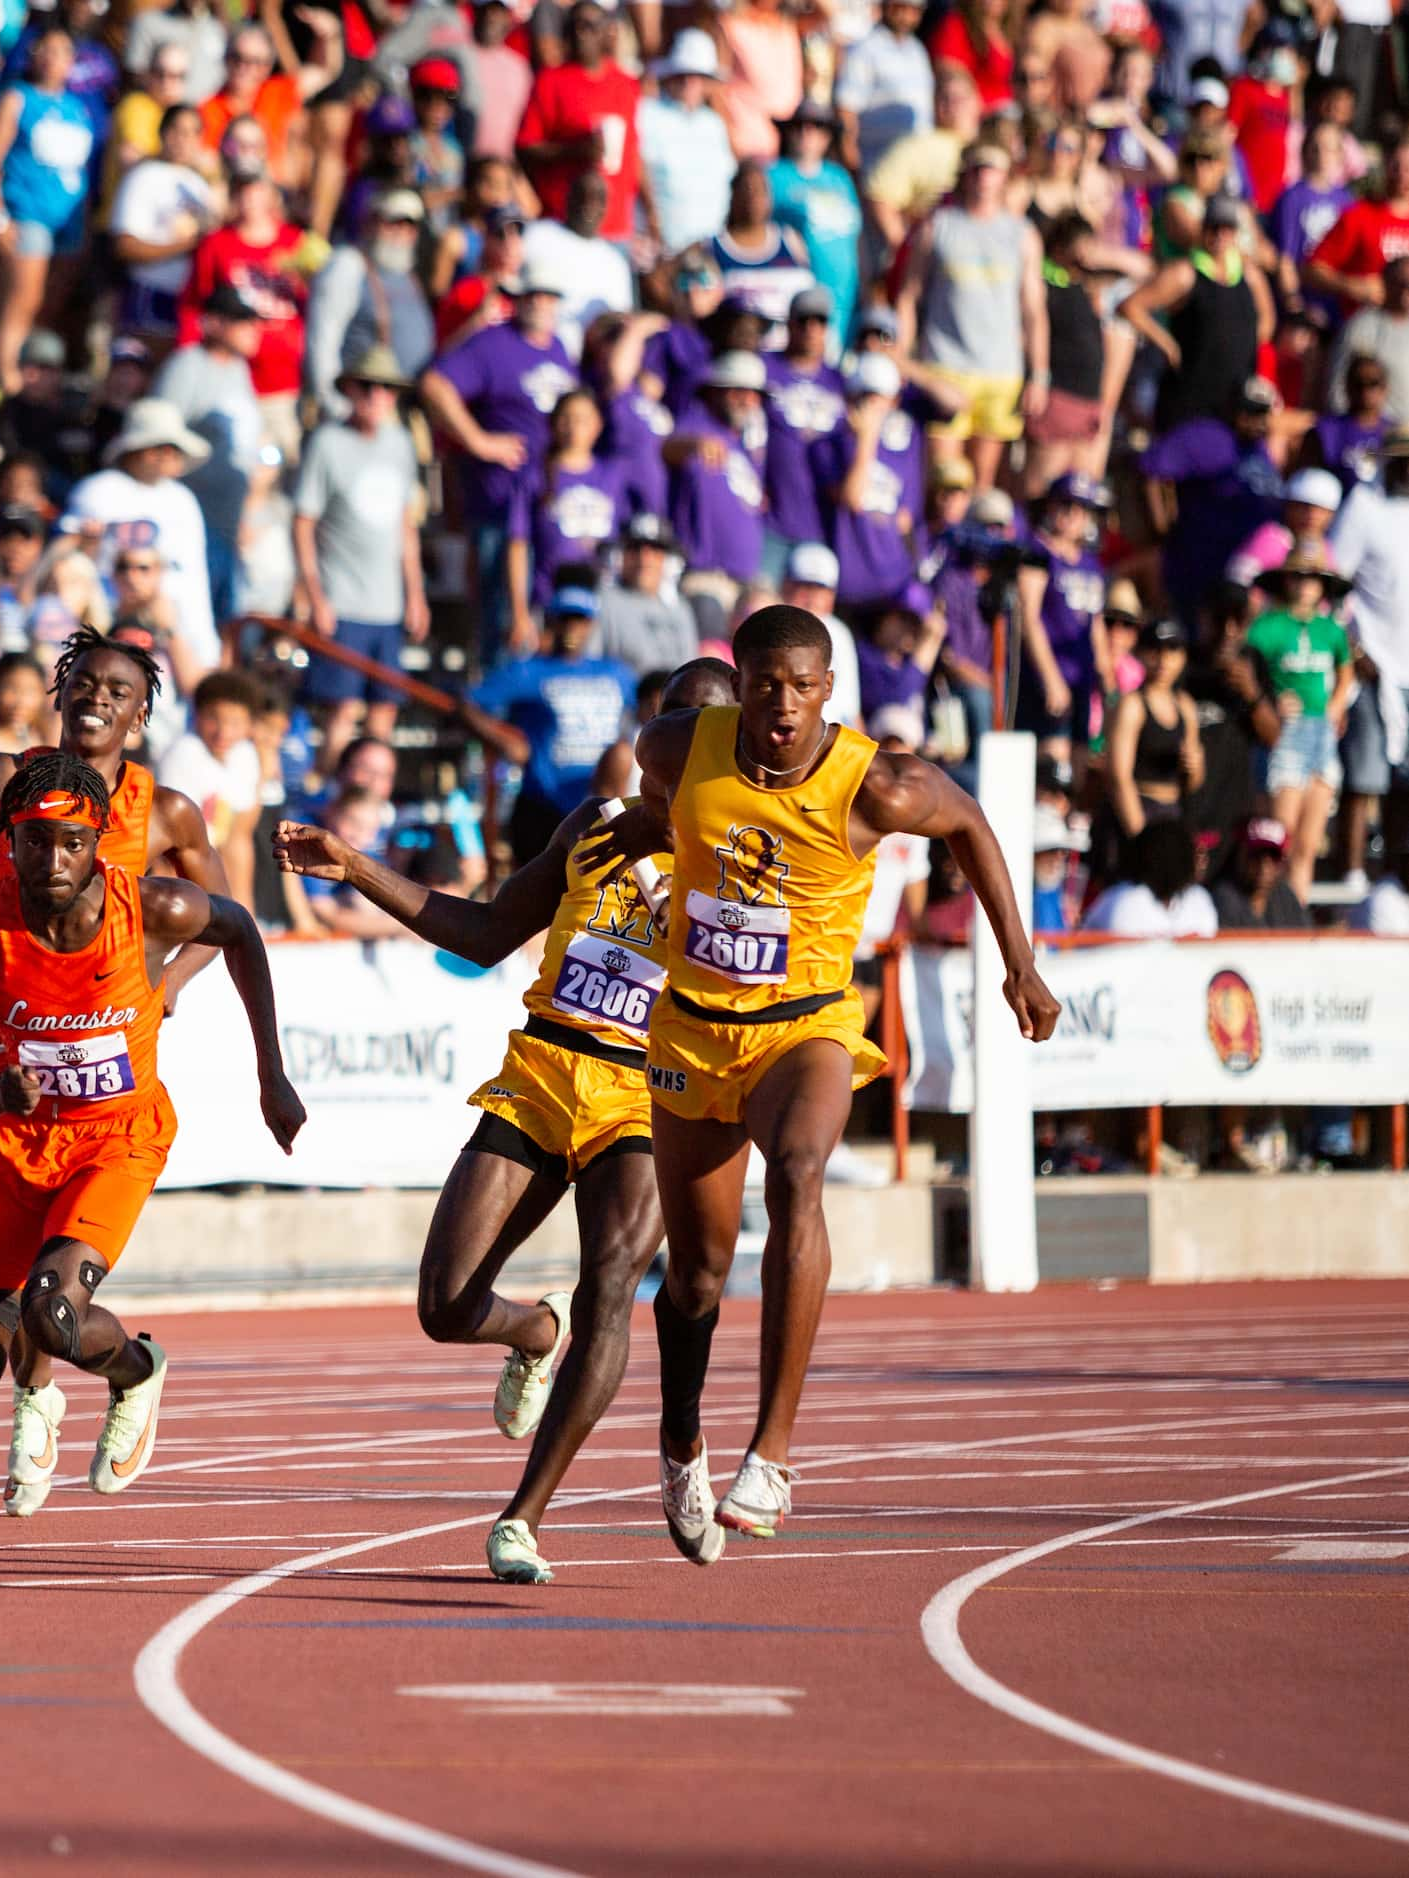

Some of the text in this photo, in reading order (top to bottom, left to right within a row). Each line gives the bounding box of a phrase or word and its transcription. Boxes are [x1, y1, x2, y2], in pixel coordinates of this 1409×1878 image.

[694, 927, 779, 972] 2607
[559, 963, 651, 1025] 2606
[4, 1000, 138, 1031] Lancaster
[38, 1060, 124, 1097] 2873
